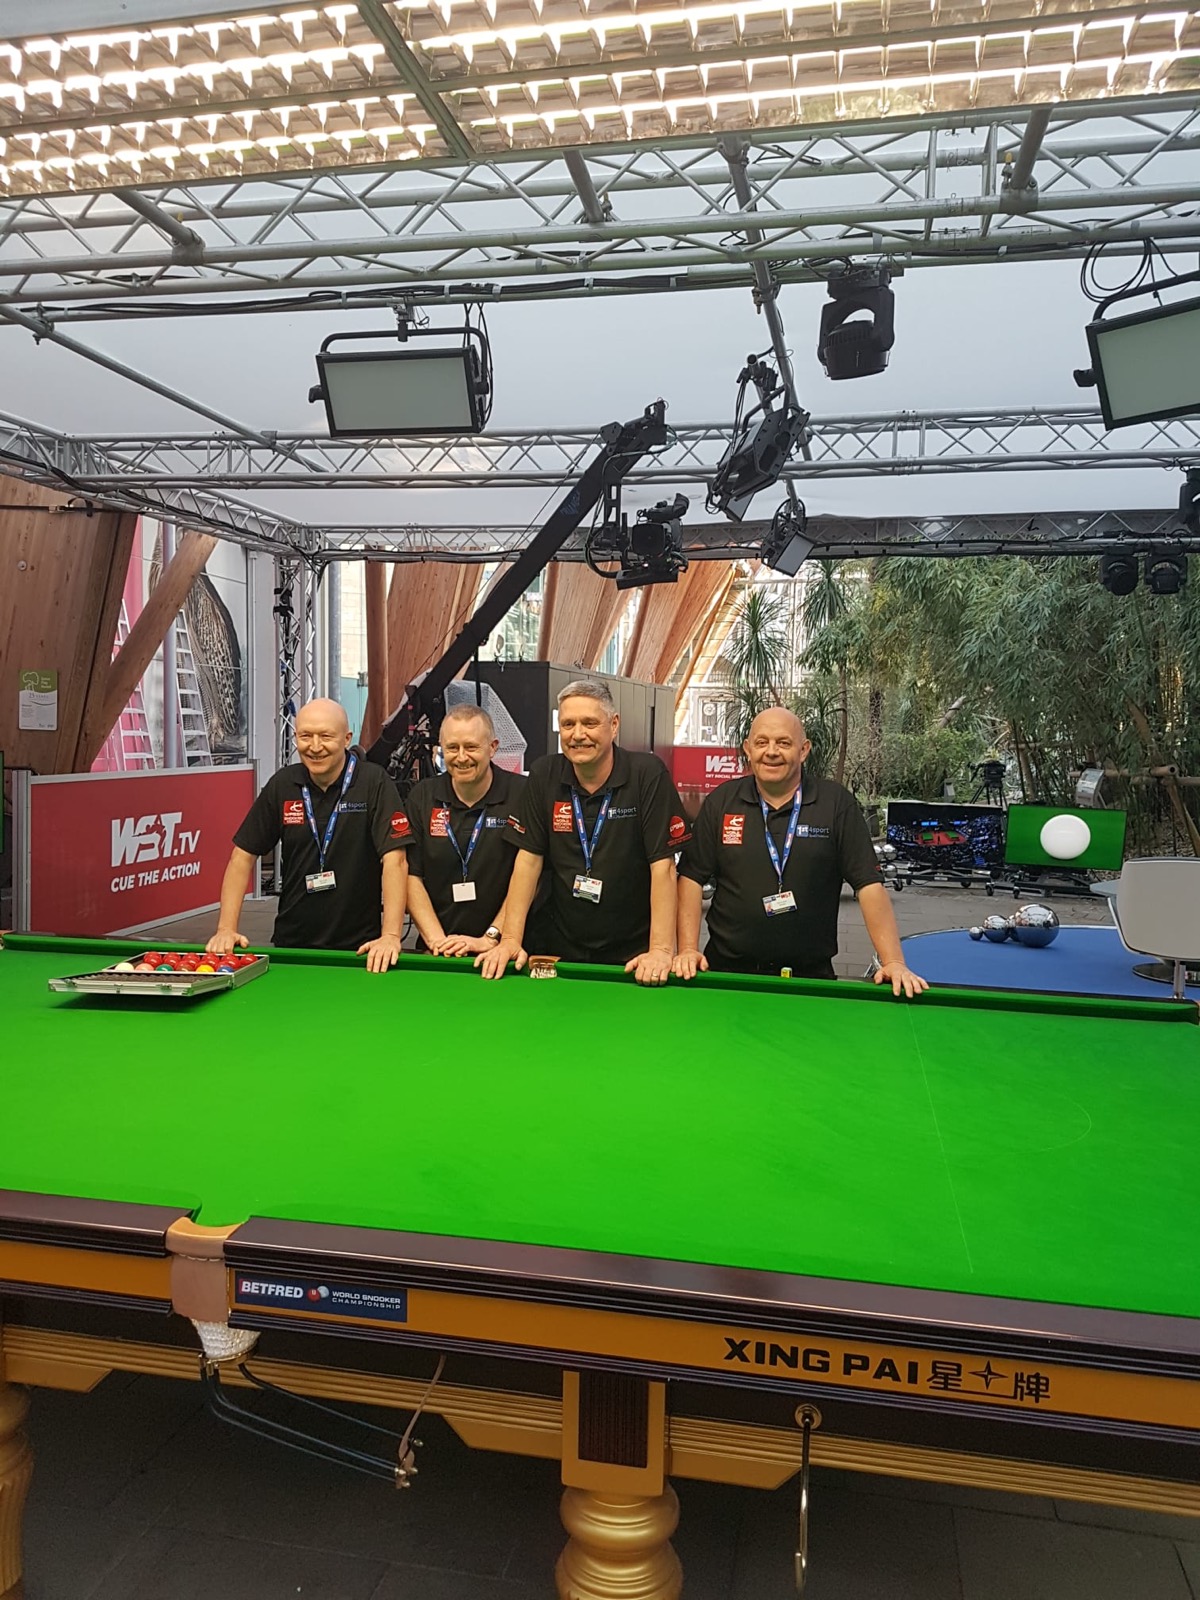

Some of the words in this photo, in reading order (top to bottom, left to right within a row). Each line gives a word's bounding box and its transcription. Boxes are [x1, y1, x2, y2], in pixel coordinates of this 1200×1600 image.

[111, 874, 136, 893] CUE
[138, 869, 160, 887] THE
[161, 861, 201, 882] ACTION
[241, 1280, 304, 1299] BETFRED
[332, 1290, 361, 1300] WORLD
[361, 1294, 401, 1304] SNOOKER
[331, 1297, 401, 1310] CHAMPIONSHIP
[723, 1337, 831, 1374] XING
[842, 1352, 919, 1385] PAI
